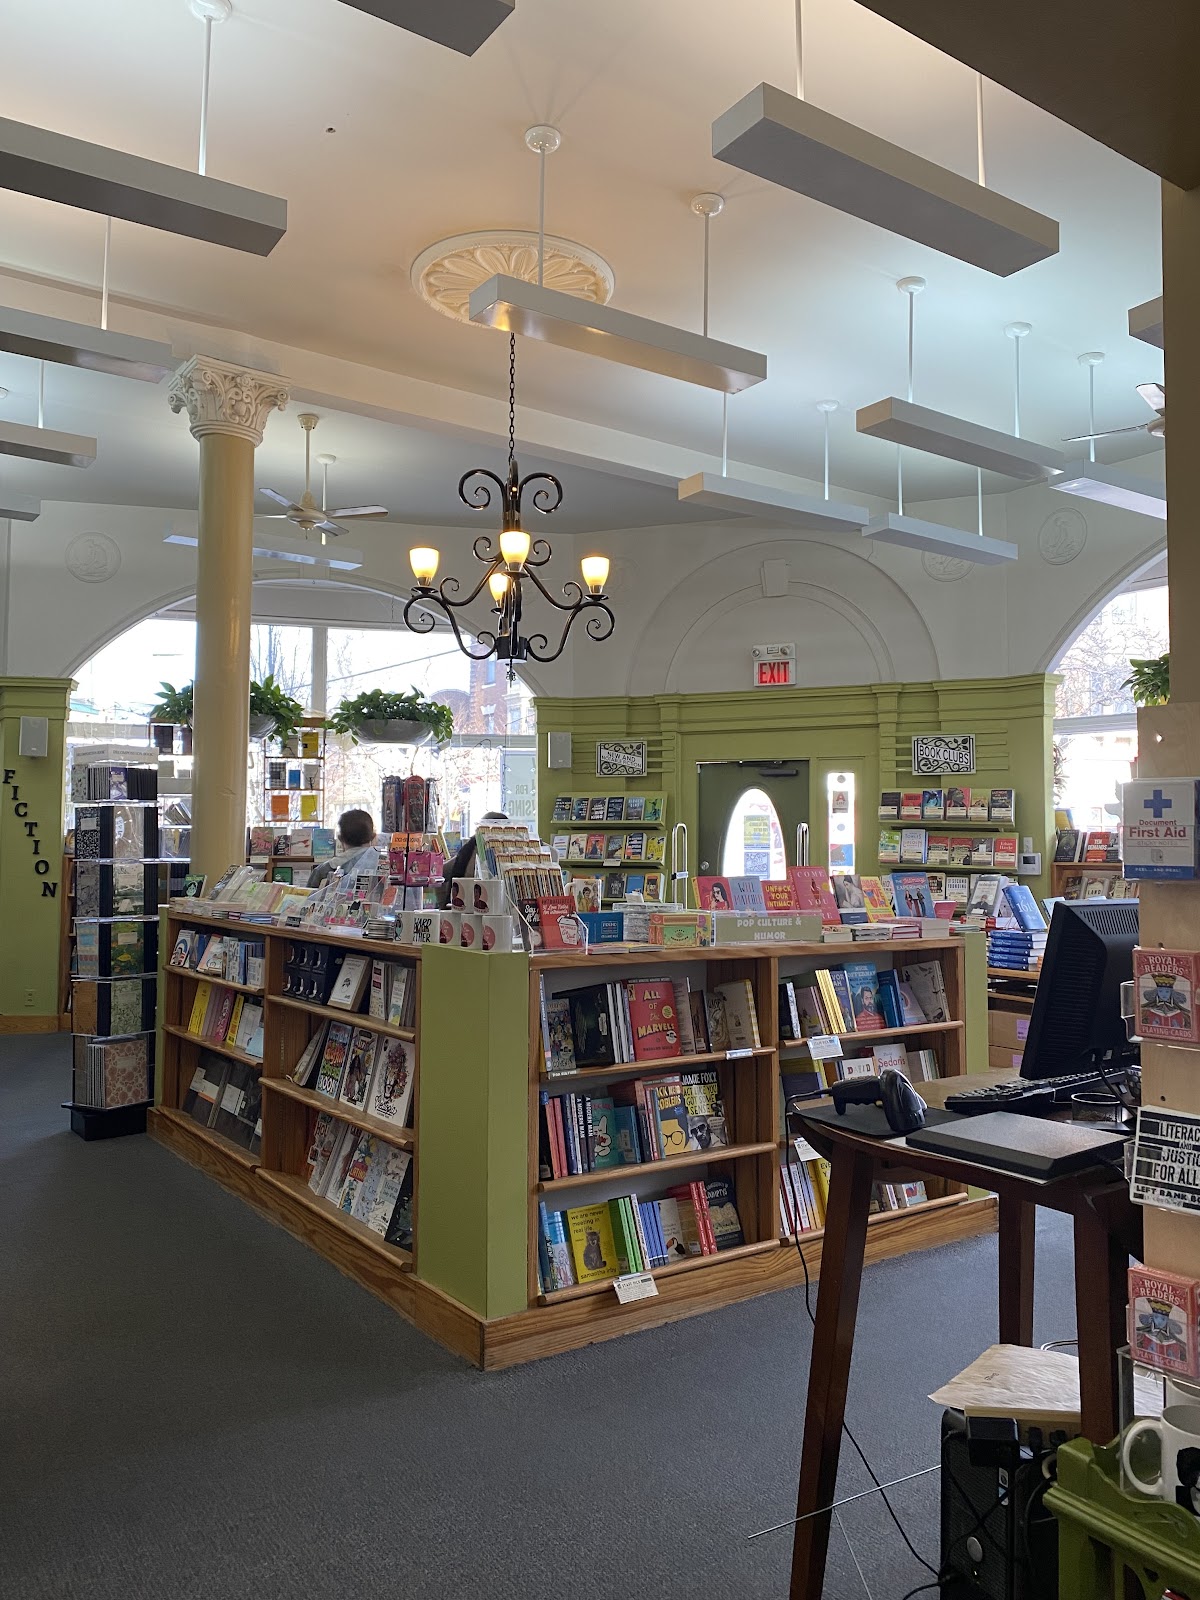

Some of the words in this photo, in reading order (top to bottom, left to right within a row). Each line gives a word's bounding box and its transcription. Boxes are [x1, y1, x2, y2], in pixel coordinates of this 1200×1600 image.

[759, 661, 790, 684] EXIT
[608, 751, 621, 759] NEW
[622, 755, 636, 763] AND
[919, 745, 942, 760] BOOK
[942, 749, 969, 765] CLUBS
[3, 769, 58, 897] FICTION
[1129, 827, 1160, 838] First
[1163, 827, 1187, 838] Aid
[797, 870, 825, 878] COME
[808, 898, 828, 906] YOU
[737, 919, 754, 927] POP
[757, 918, 793, 927] CULTURE
[754, 931, 786, 940] HUMOR
[1148, 956, 1177, 966] ROYAL
[1144, 964, 1184, 975] READERS
[643, 990, 660, 1000] ALL
[637, 1023, 675, 1038] MARVELS
[1142, 1026, 1169, 1036] PLAYING
[1170, 1028, 1192, 1038] CARDS
[878, 1056, 906, 1068] Sedaris
[847, 1064, 871, 1074] DAVID
[681, 1073, 700, 1086] JAMIE
[701, 1071, 717, 1083] FOXX
[683, 1086, 693, 1096] ACT
[658, 1095, 681, 1110] OBLEMS
[684, 1095, 696, 1106] GOT
[576, 1103, 584, 1125] MODERN
[584, 1102, 593, 1124] MODERN
[688, 1103, 713, 1116] SENSE
[1180, 1141, 1192, 1151] AND
[1153, 1163, 1175, 1182] FOR
[1178, 1167, 1199, 1186] ALL
[1136, 1184, 1157, 1194] LEFT
[1160, 1188, 1187, 1201] BANK
[580, 1269, 606, 1280] samantha
[1144, 1280, 1174, 1294] ROYAL
[1140, 1288, 1180, 1305] READERS
